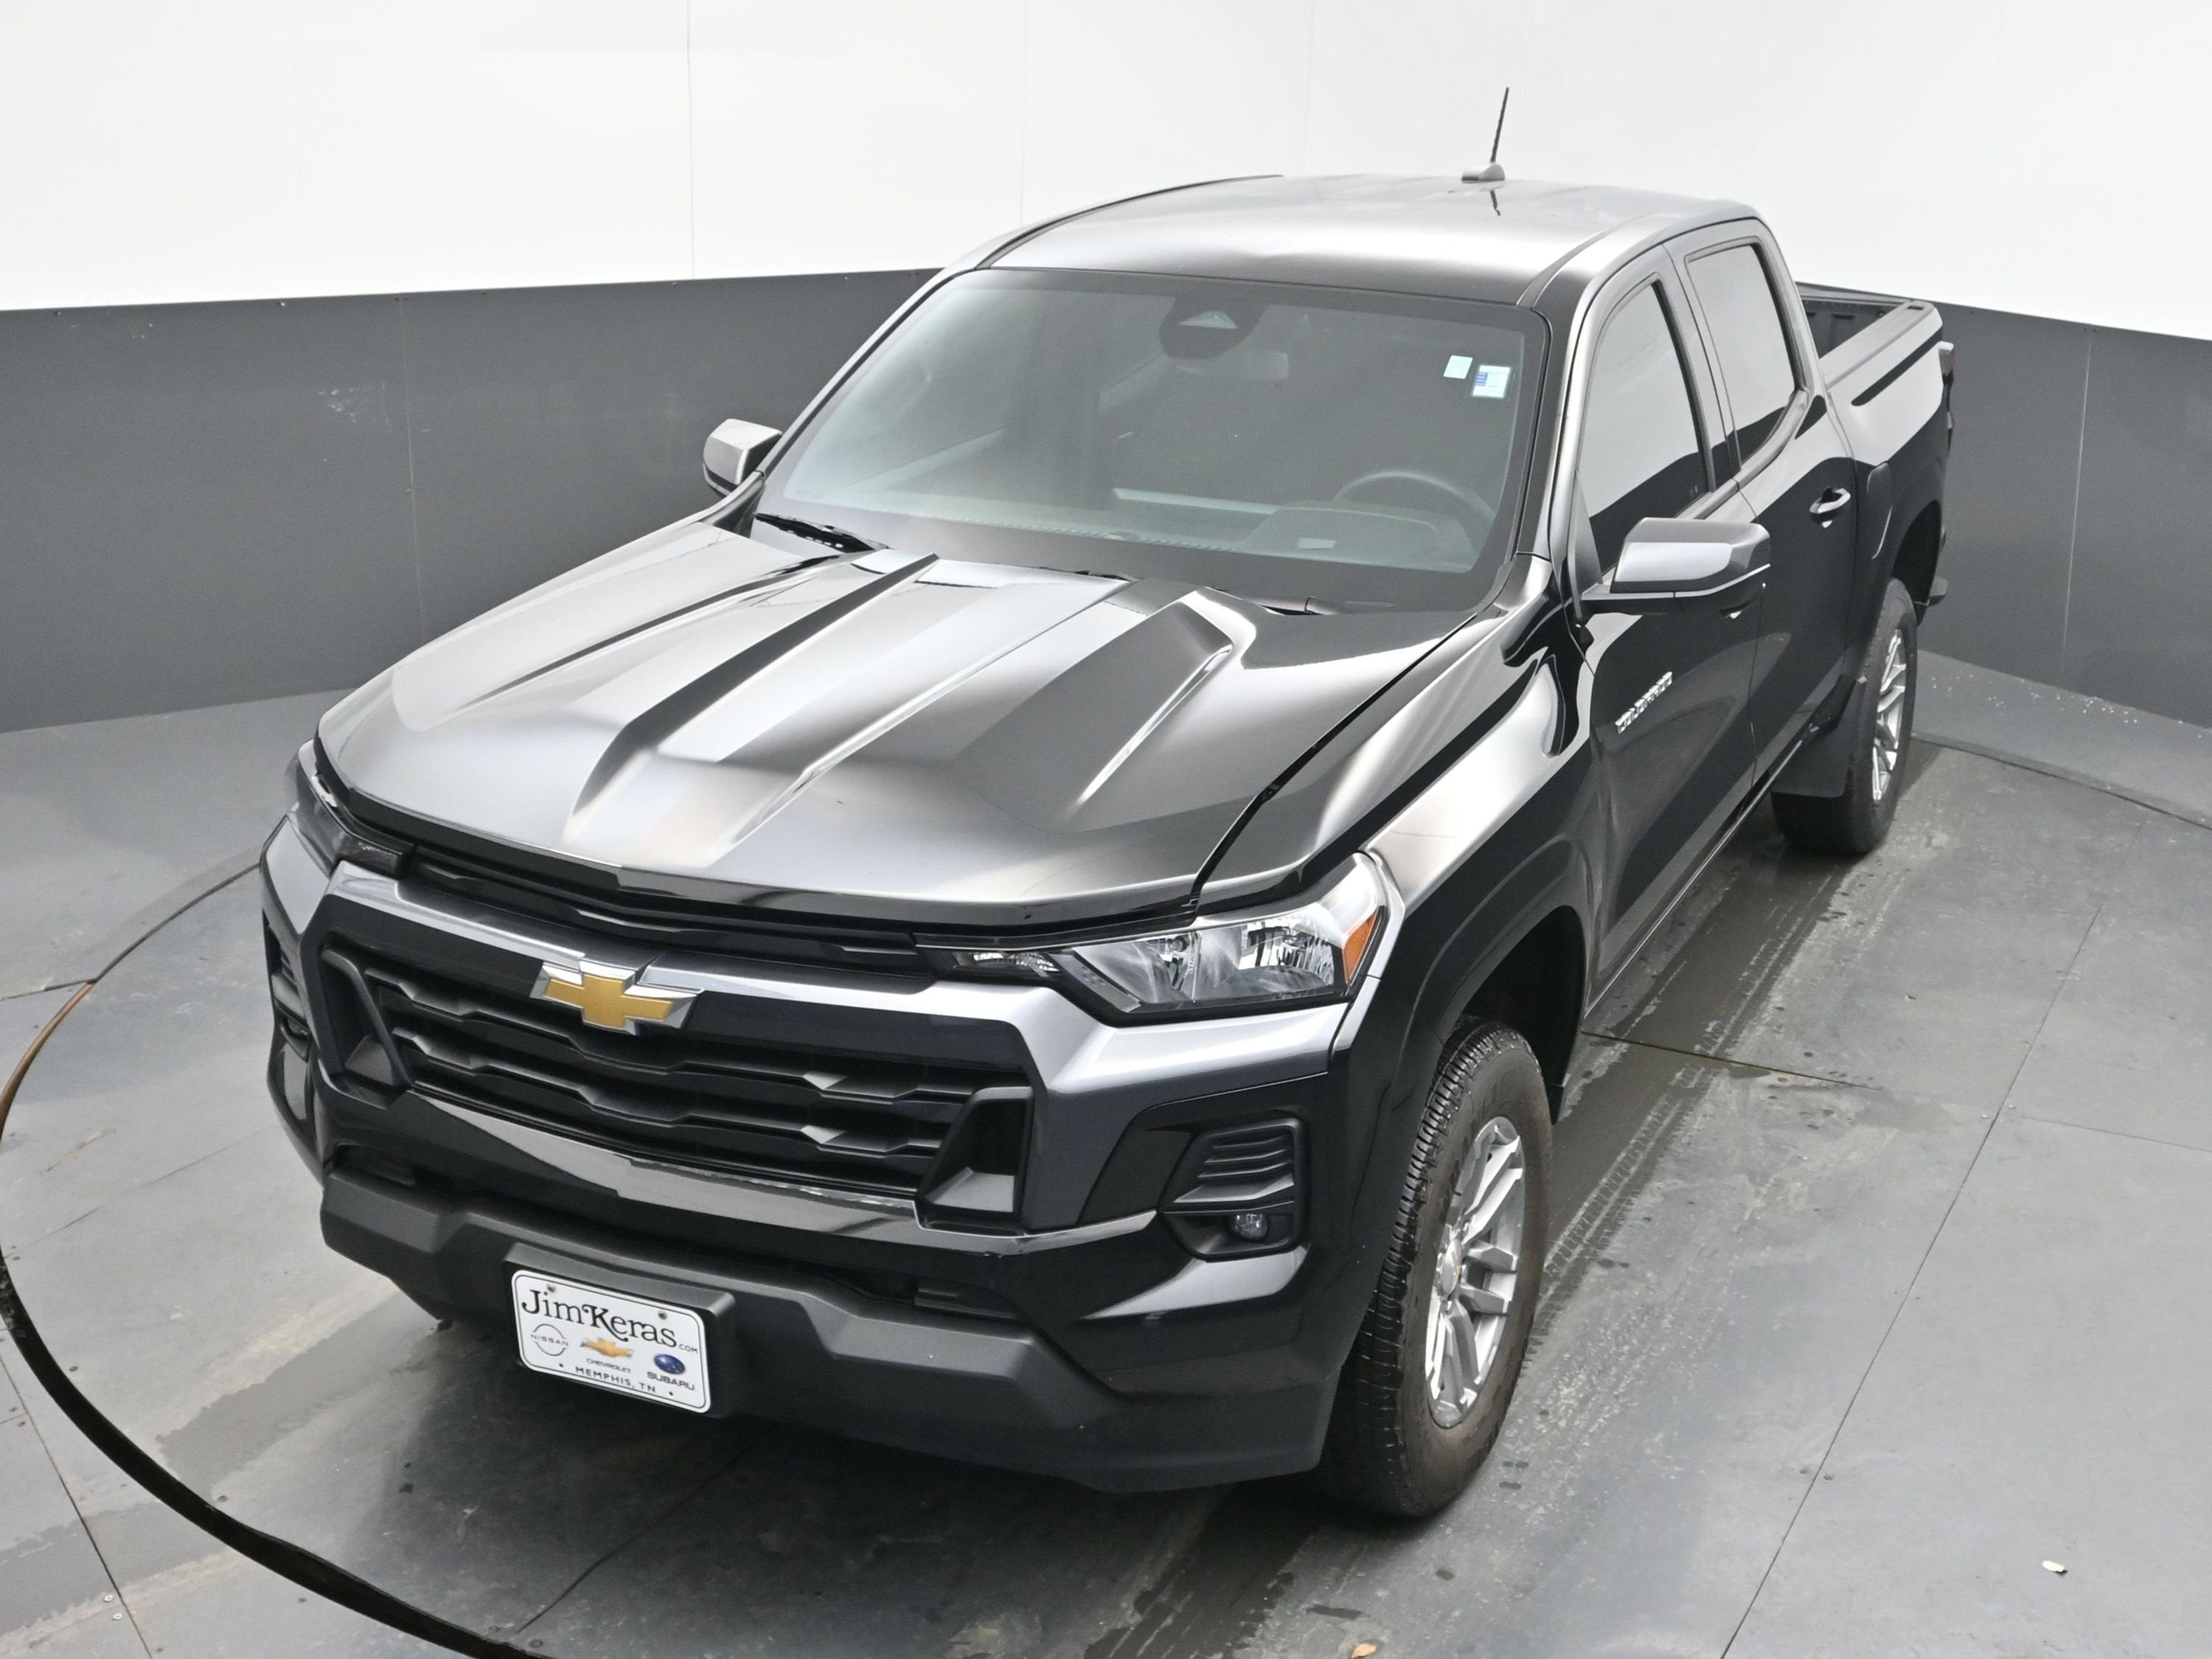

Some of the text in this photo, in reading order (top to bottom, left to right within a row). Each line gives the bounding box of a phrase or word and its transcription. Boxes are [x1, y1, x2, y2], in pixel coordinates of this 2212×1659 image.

[531, 1333, 568, 1346] NISSAN
[586, 1358, 631, 1373] CHEVROLET
[575, 1366, 655, 1393] MEMPHIS, TN
[647, 1371, 695, 1391] SUBARU
